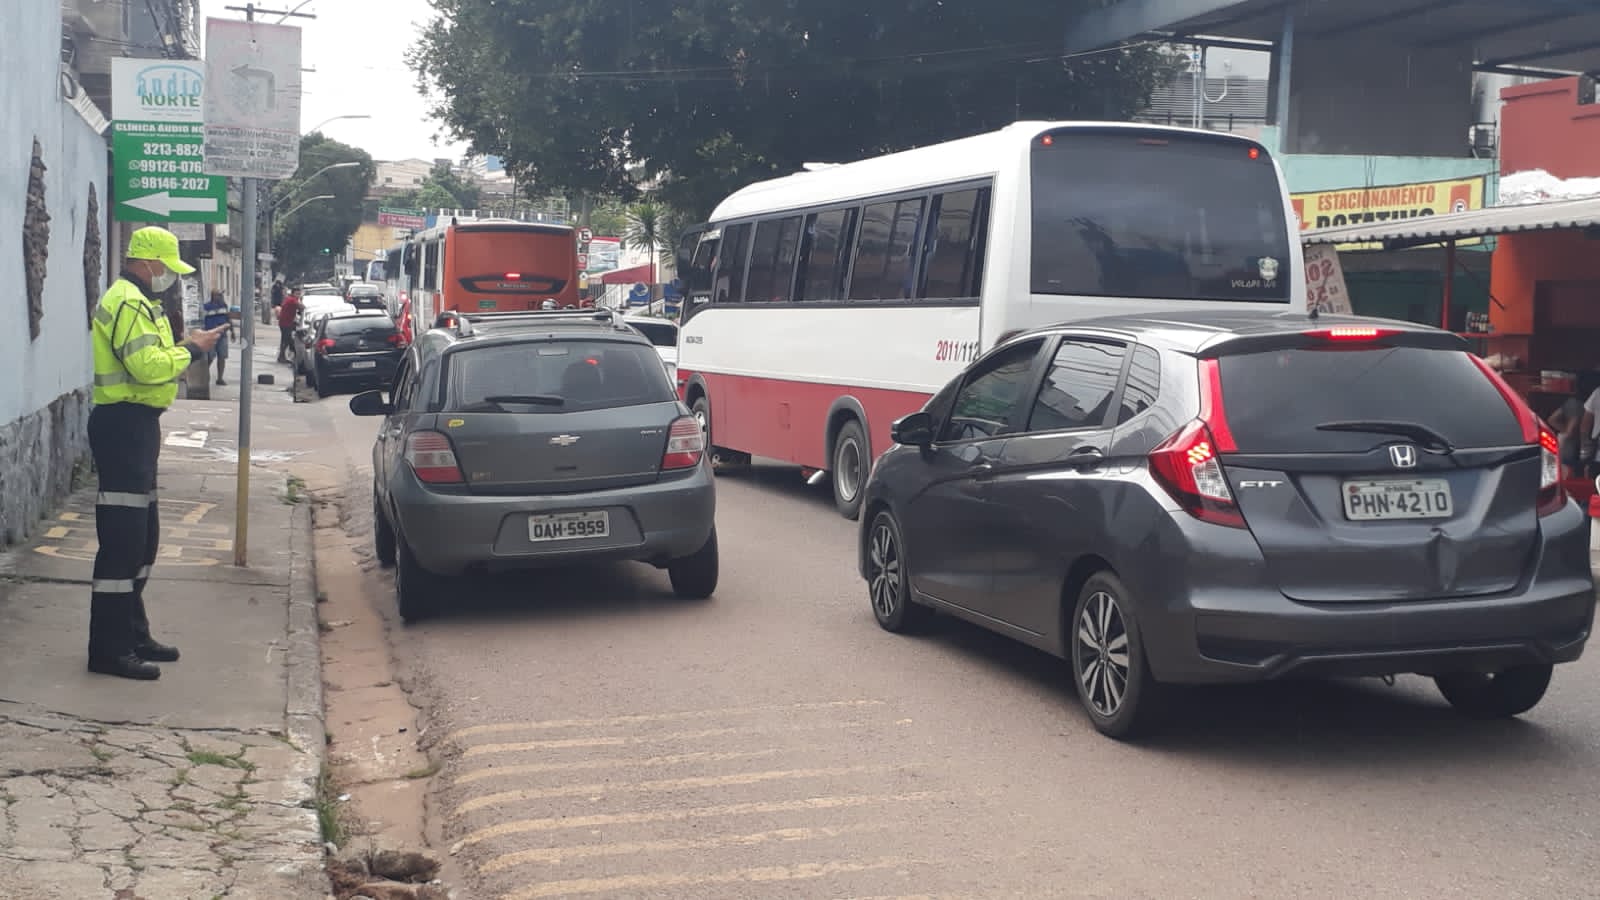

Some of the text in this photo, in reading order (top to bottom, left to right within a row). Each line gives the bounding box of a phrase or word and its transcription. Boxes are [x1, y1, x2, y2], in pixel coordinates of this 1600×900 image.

[141, 93, 200, 107] NORTE
[191, 125, 204, 134] NO
[140, 159, 203, 173] 99126-076
[141, 176, 210, 190] 98146-2027
[1317, 185, 1436, 212] ESTACIONAMENTO
[1240, 480, 1283, 488] FIT
